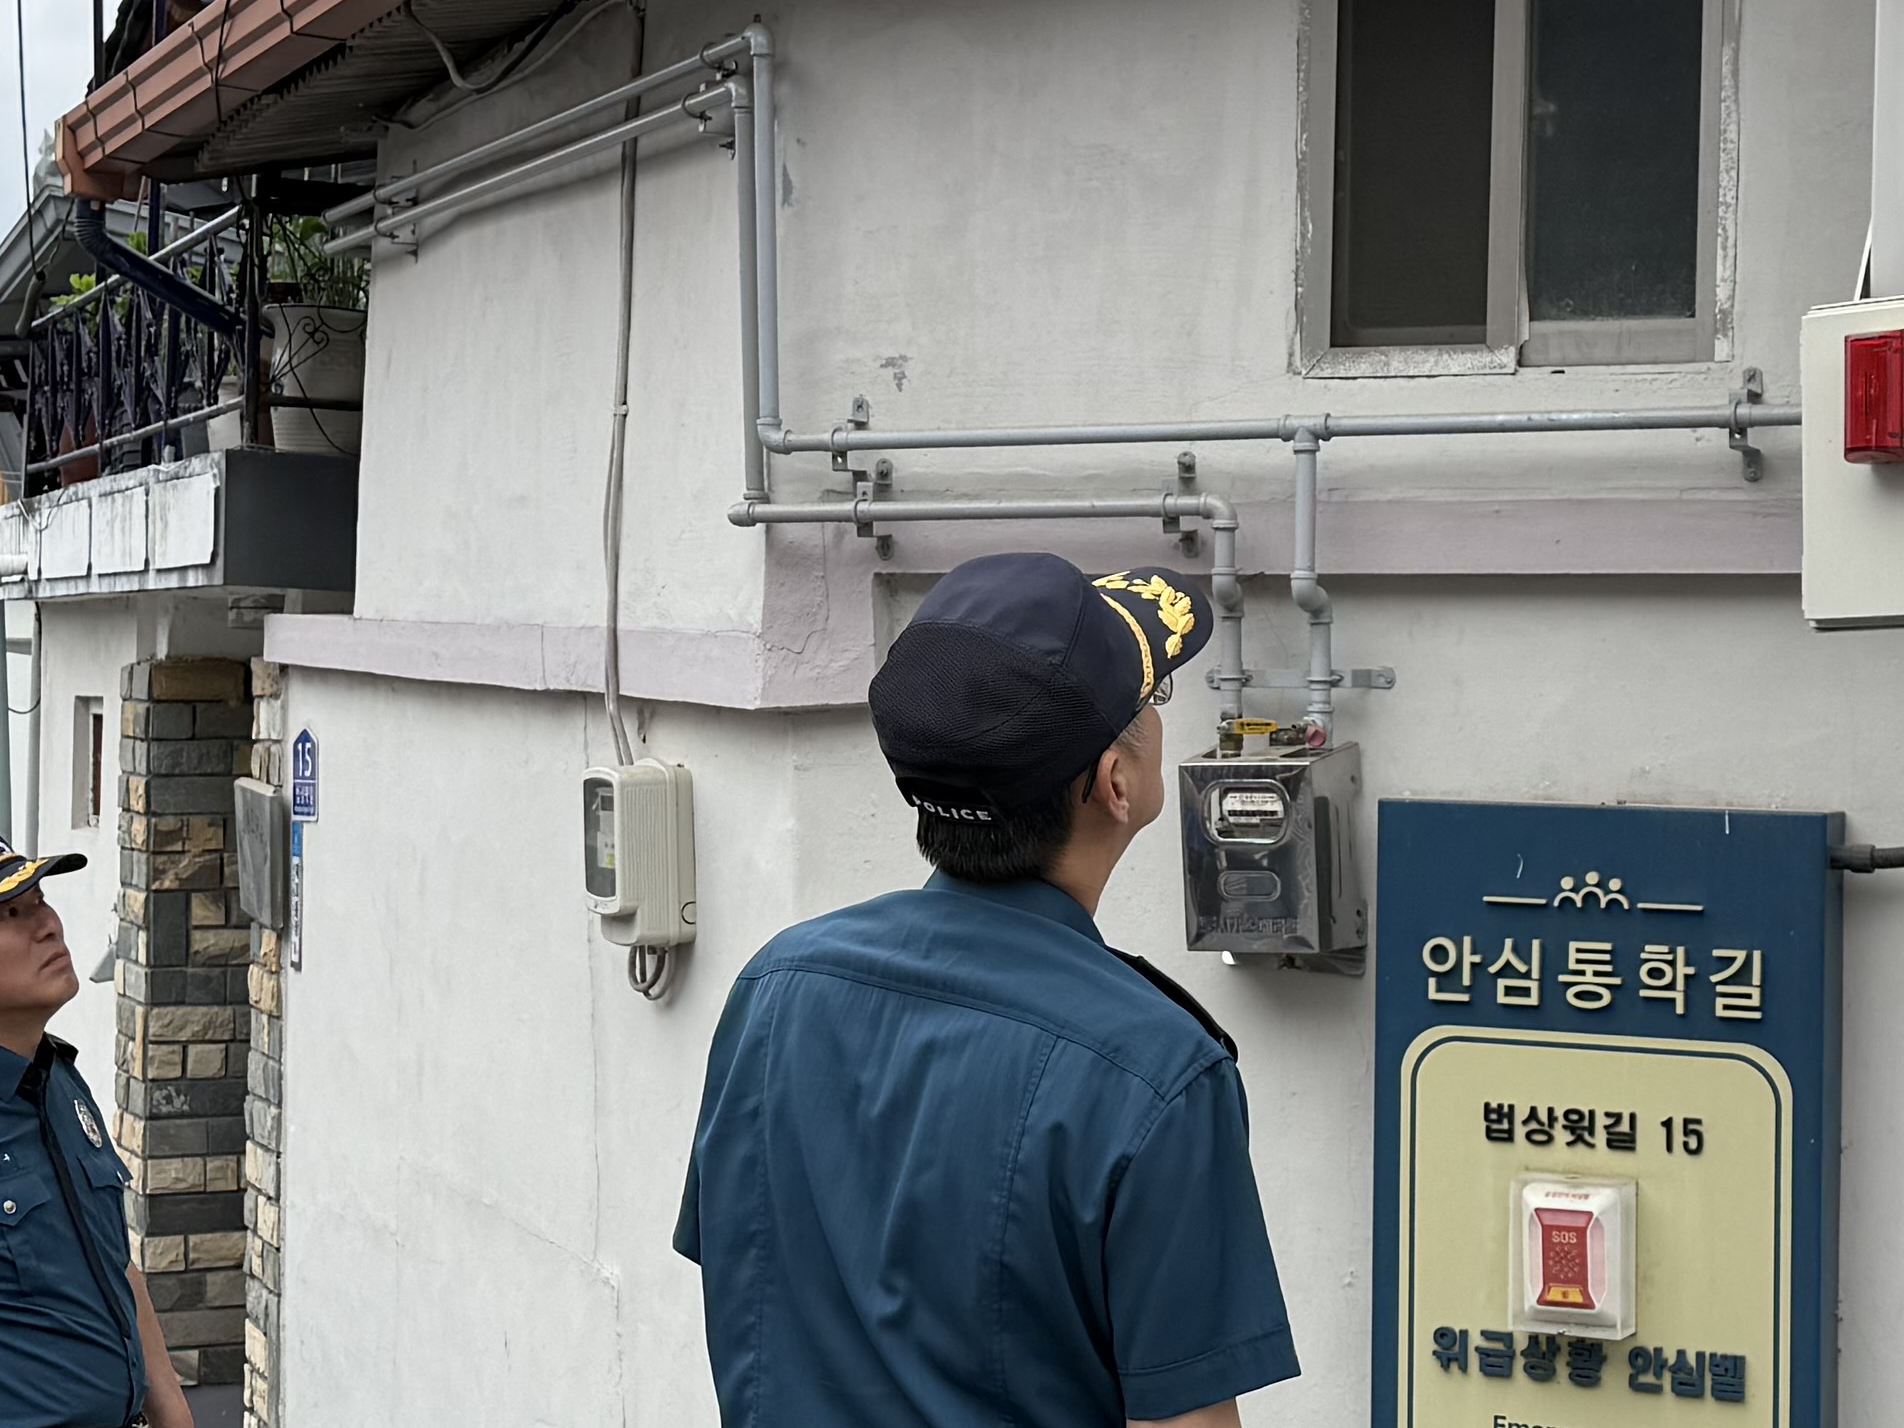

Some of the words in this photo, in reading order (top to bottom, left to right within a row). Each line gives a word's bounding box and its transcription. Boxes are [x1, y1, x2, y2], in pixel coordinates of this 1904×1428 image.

[298, 742, 312, 777] 15
[1422, 935, 1764, 1019] 안심통학길
[1483, 1101, 1639, 1153] 법상윗길
[1660, 1116, 1705, 1156] 15
[1552, 1231, 1577, 1244] SOS
[1432, 1325, 1608, 1388] 위급상황
[1628, 1345, 1747, 1404] 안심벨
